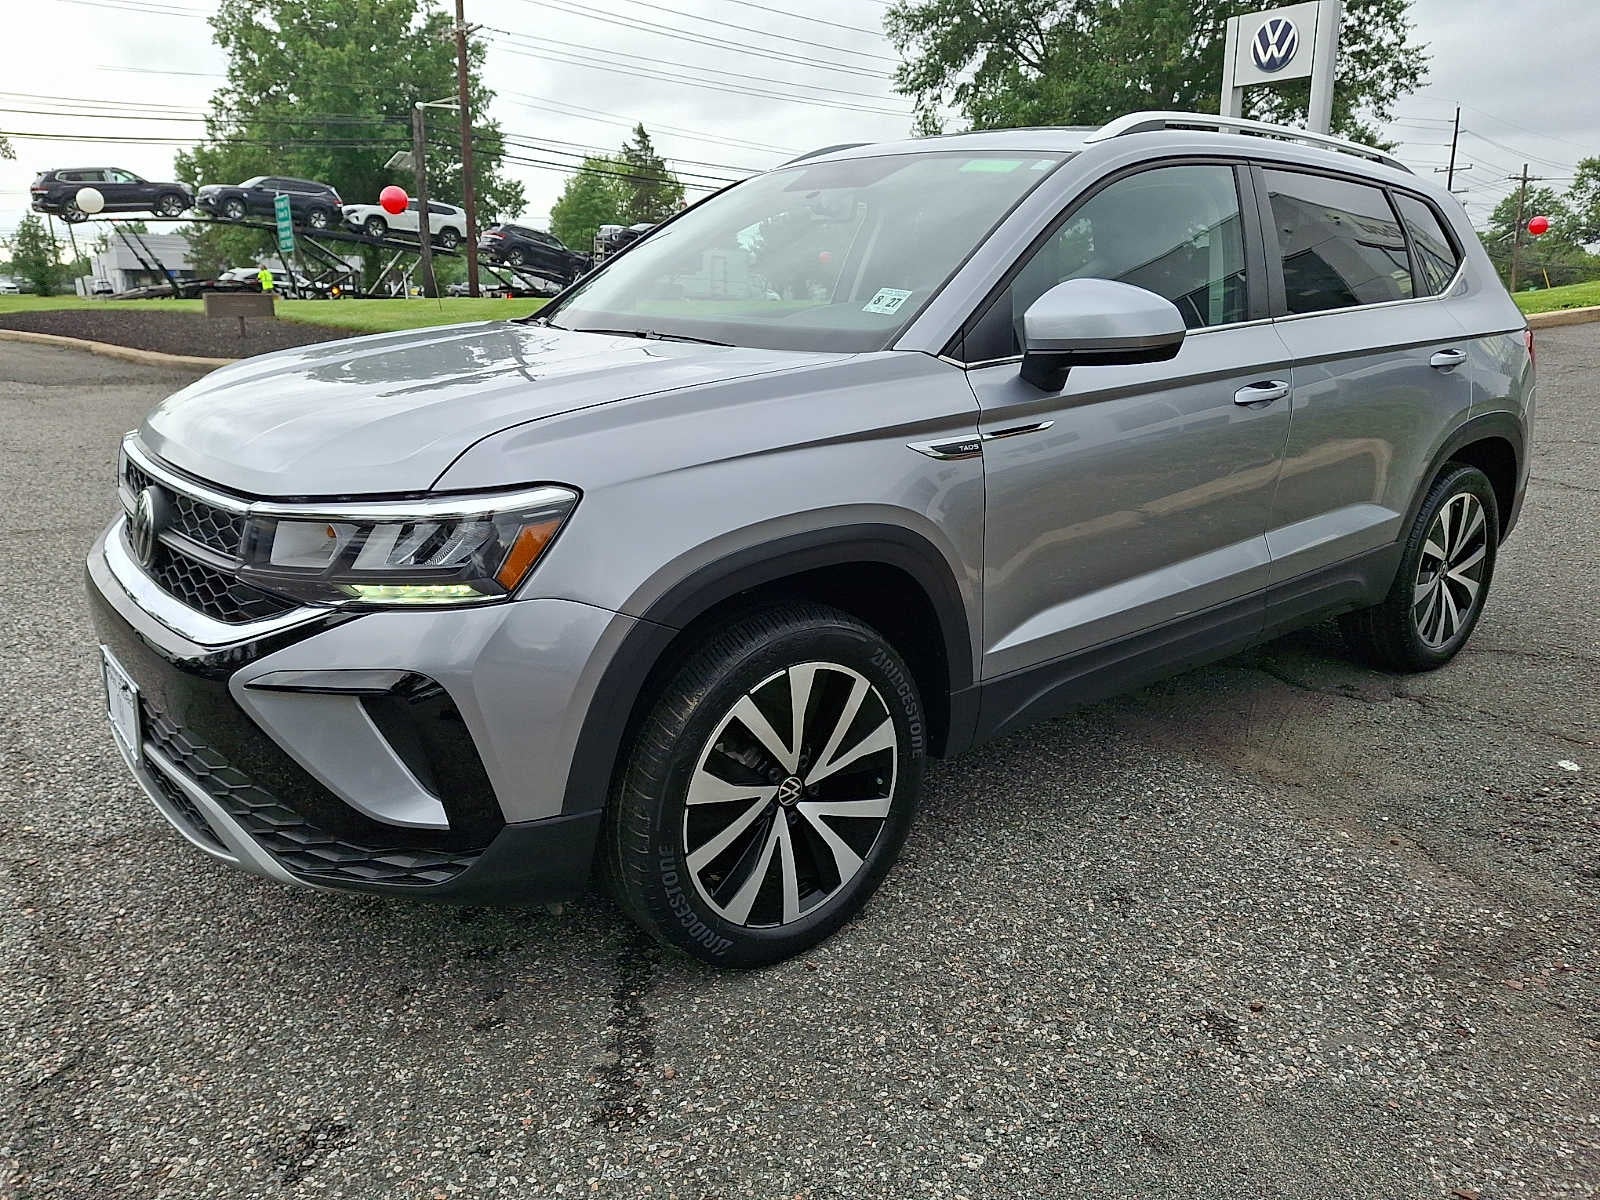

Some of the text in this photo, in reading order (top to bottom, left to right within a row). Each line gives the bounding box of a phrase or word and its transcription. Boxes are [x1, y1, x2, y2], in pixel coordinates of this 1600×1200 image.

[1251, 18, 1298, 71] VW
[873, 295, 885, 305] 8
[885, 297, 903, 308] 27
[958, 443, 980, 452] TAOS
[871, 647, 923, 760] BRIDGESTONE
[658, 844, 734, 955] BRIDGESTONE
